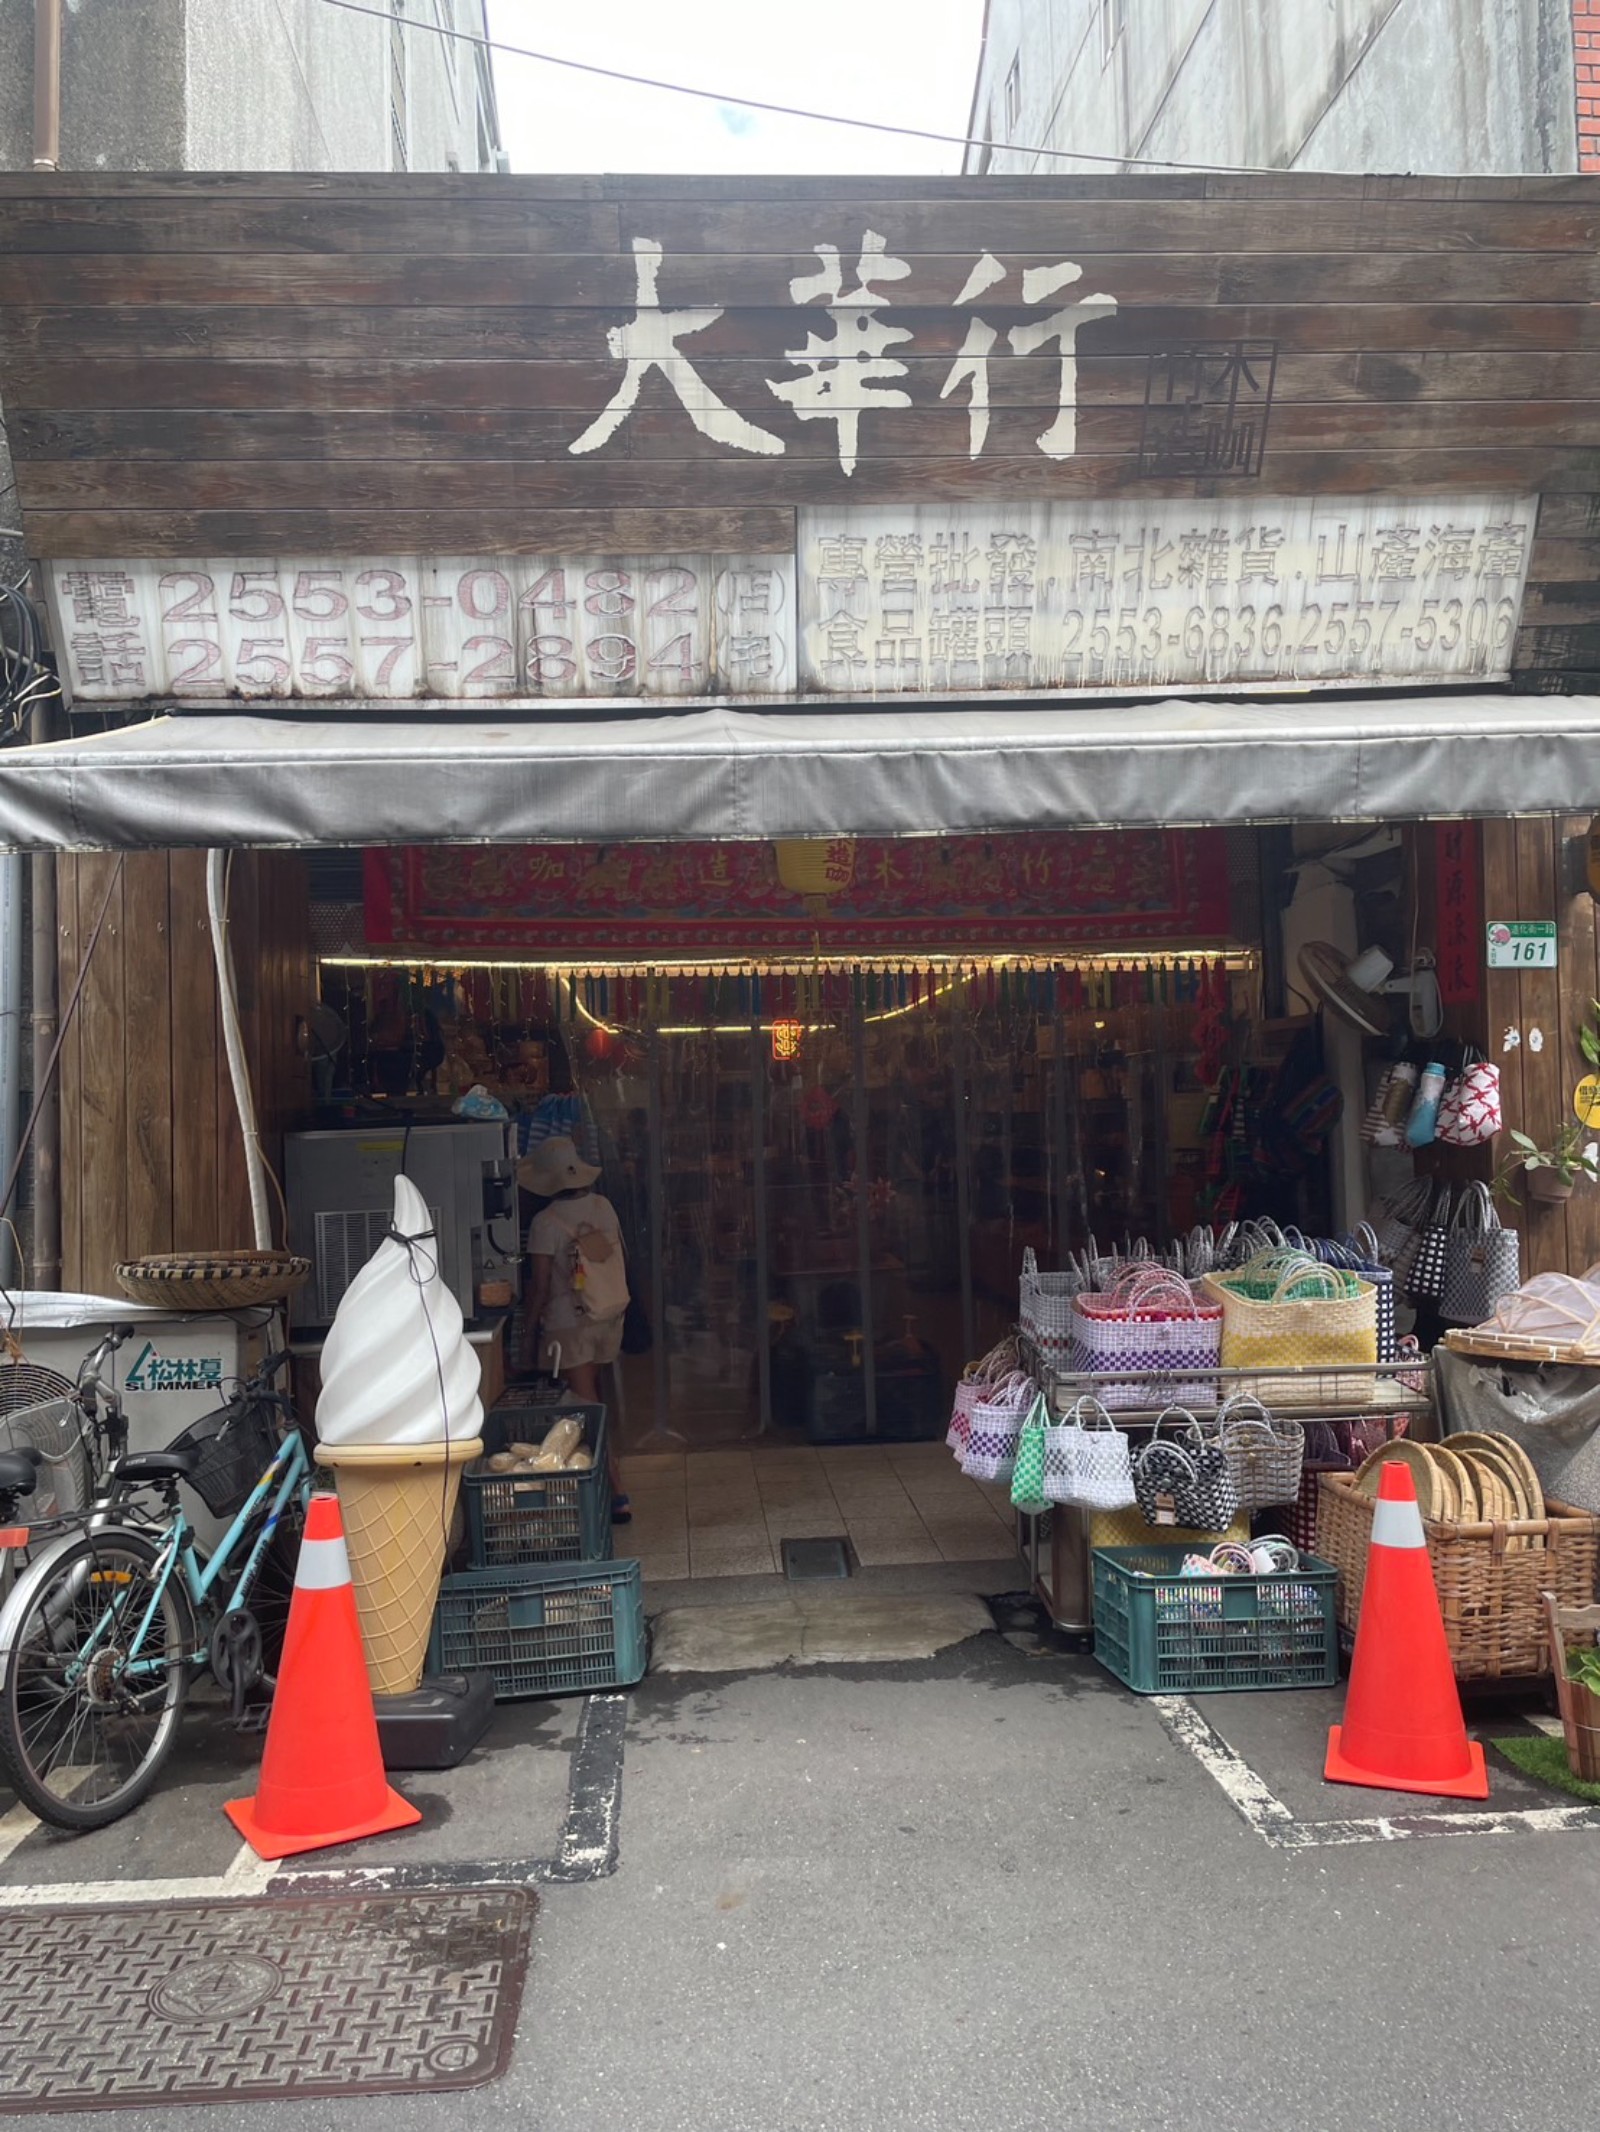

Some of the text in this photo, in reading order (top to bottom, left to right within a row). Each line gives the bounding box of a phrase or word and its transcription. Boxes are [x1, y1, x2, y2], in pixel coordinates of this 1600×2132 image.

[568, 229, 1117, 476] 大華行
[818, 606, 1033, 668] 食品罐頭
[1512, 942, 1547, 961] 161
[124, 1380, 222, 1392] SUMMER
